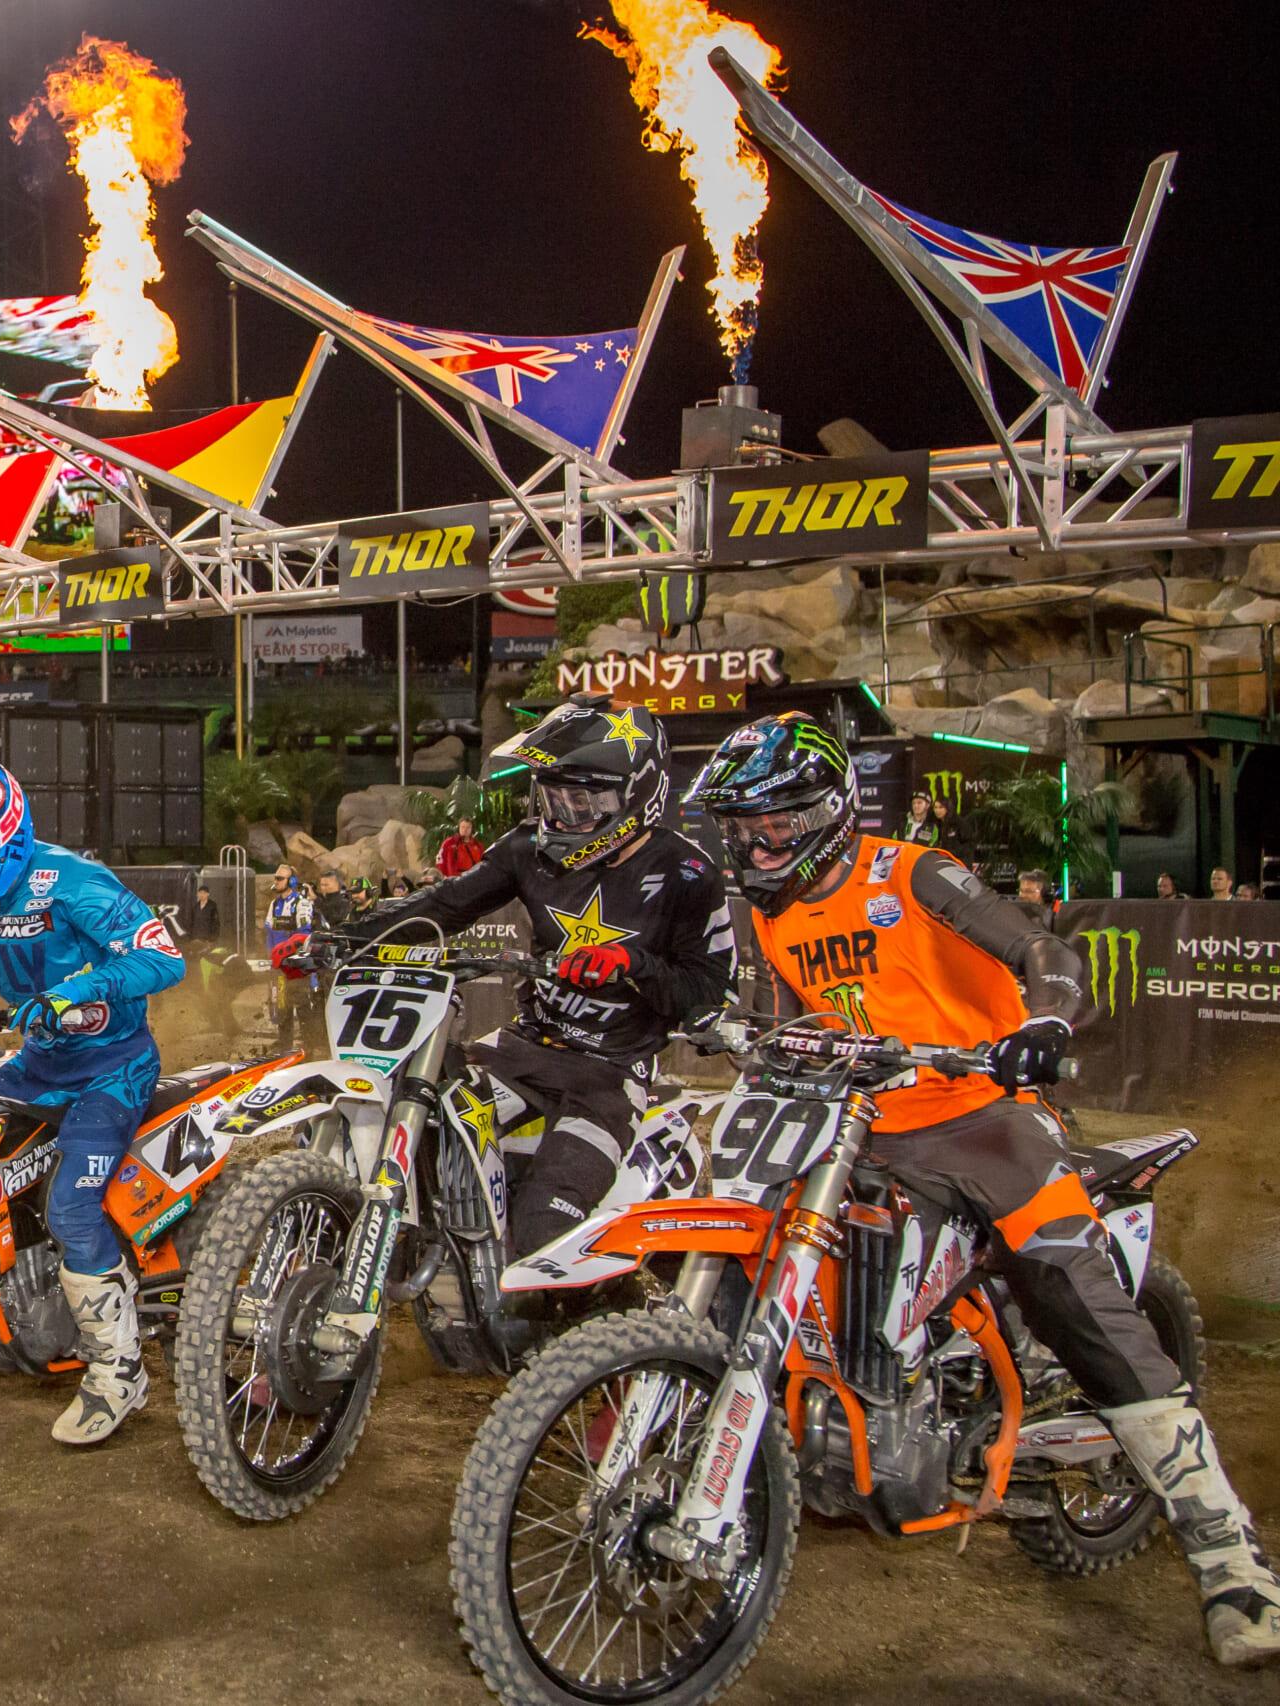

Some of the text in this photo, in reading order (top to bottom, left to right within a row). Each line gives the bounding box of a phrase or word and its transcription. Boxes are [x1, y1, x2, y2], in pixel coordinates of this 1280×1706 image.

[728, 476, 909, 537] THOR
[349, 525, 476, 578] THOR
[65, 562, 151, 608] THOR
[253, 643, 351, 656] TEAM STORE
[286, 624, 337, 638] Majestic
[557, 648, 784, 693] MONSTER
[644, 693, 744, 712] ERGY
[561, 816, 639, 869] ROCKSTAR
[787, 929, 879, 988] THOR
[1177, 936, 1280, 959] MONST
[1196, 963, 1280, 974] ENERG
[1146, 967, 1167, 976] AMA
[1146, 979, 1280, 1001] SUPERC
[336, 988, 428, 1051] 15
[534, 977, 630, 1022] SHIFT
[1215, 1009, 1239, 1020] World
[32, 1136, 60, 1162] MOUNT
[161, 1111, 215, 1179] 4
[712, 1098, 830, 1185] 90
[87, 1155, 116, 1176] FLY
[150, 1200, 189, 1236] MOTOREX
[642, 1220, 748, 1233] TEDDER
[351, 1205, 385, 1305] DUNLOP
[373, 1212, 402, 1290] MOTOREX
[727, 1389, 756, 1432] OIL
[701, 1427, 742, 1510] LUCAS
